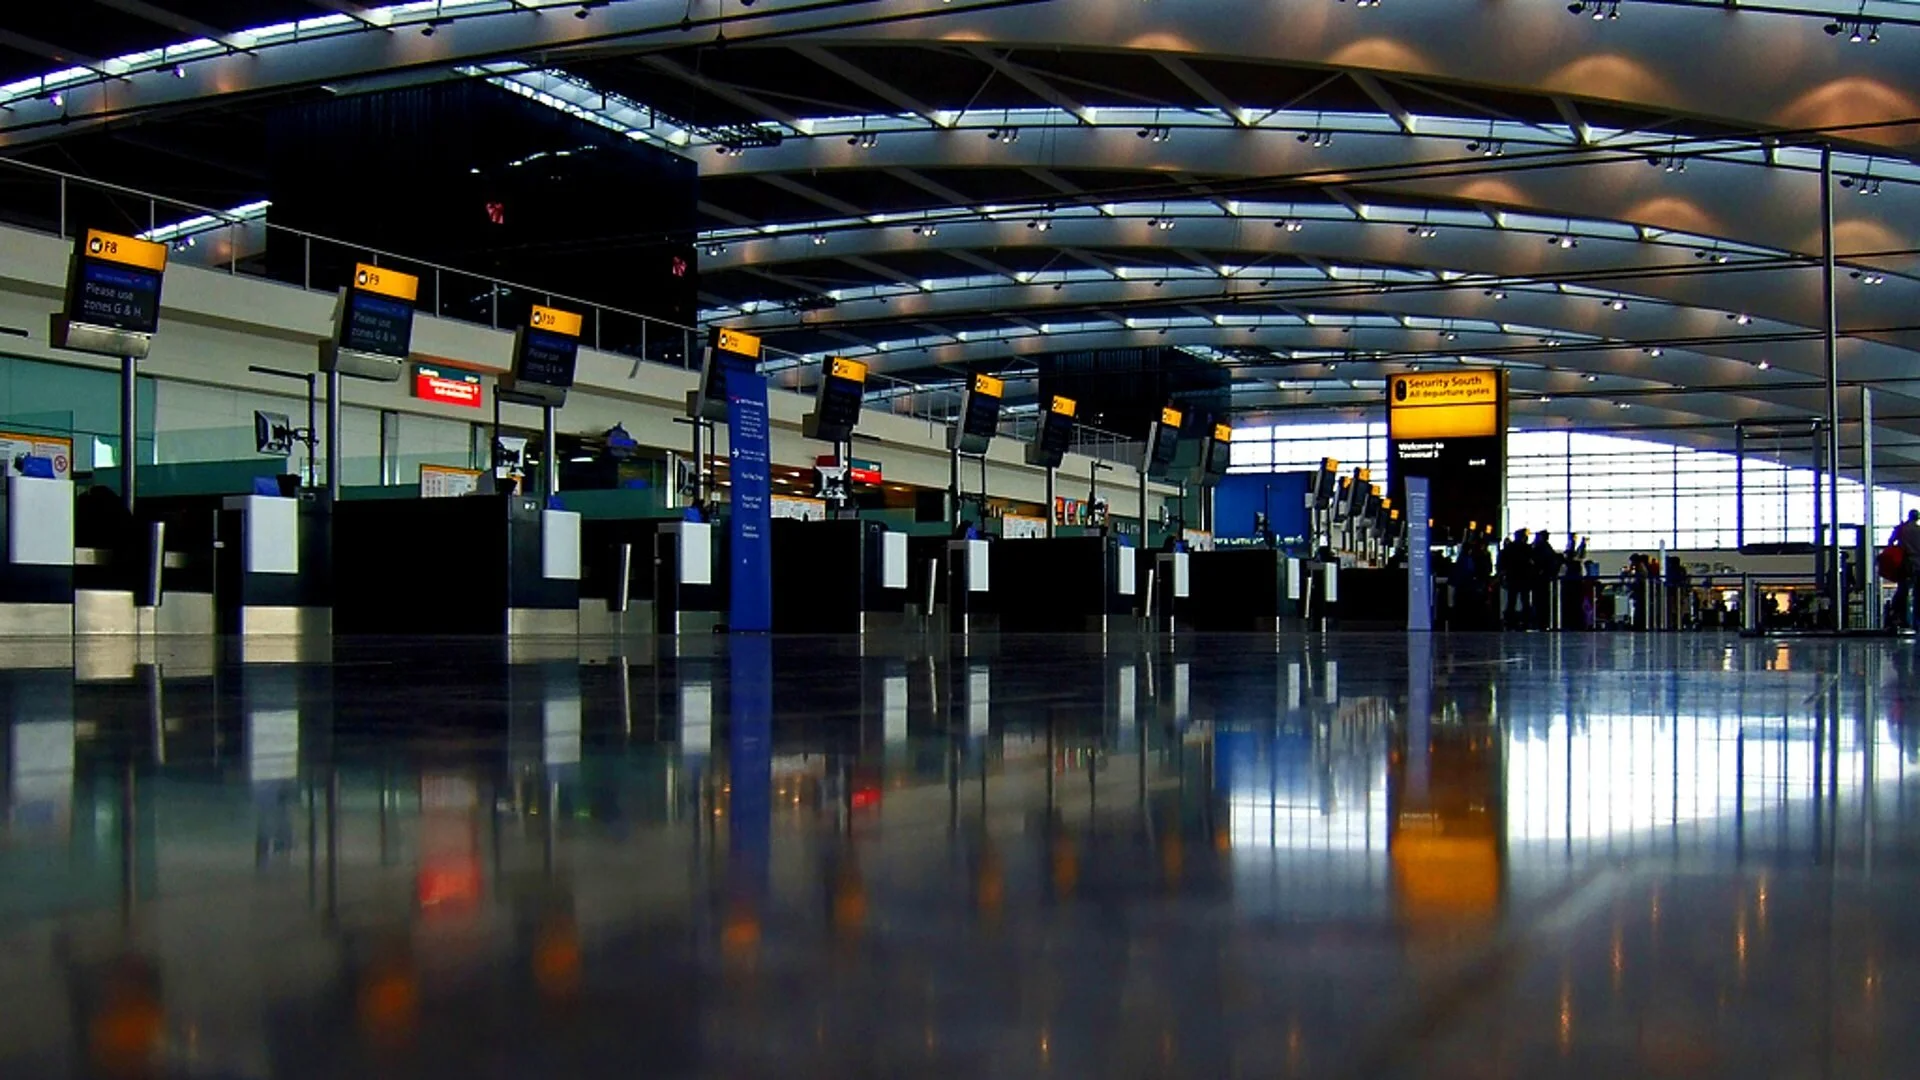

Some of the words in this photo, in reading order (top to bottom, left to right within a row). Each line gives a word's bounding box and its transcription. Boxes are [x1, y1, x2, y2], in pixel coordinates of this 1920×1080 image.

[104, 241, 118, 254] F8
[368, 273, 380, 286] F9
[86, 282, 116, 297] Please
[83, 299, 112, 313] zones
[113, 303, 121, 315] G
[1408, 379, 1450, 389] Security
[1451, 375, 1483, 386] South
[1409, 390, 1421, 398] All
[1422, 389, 1465, 399] departure
[1466, 387, 1491, 397] gates
